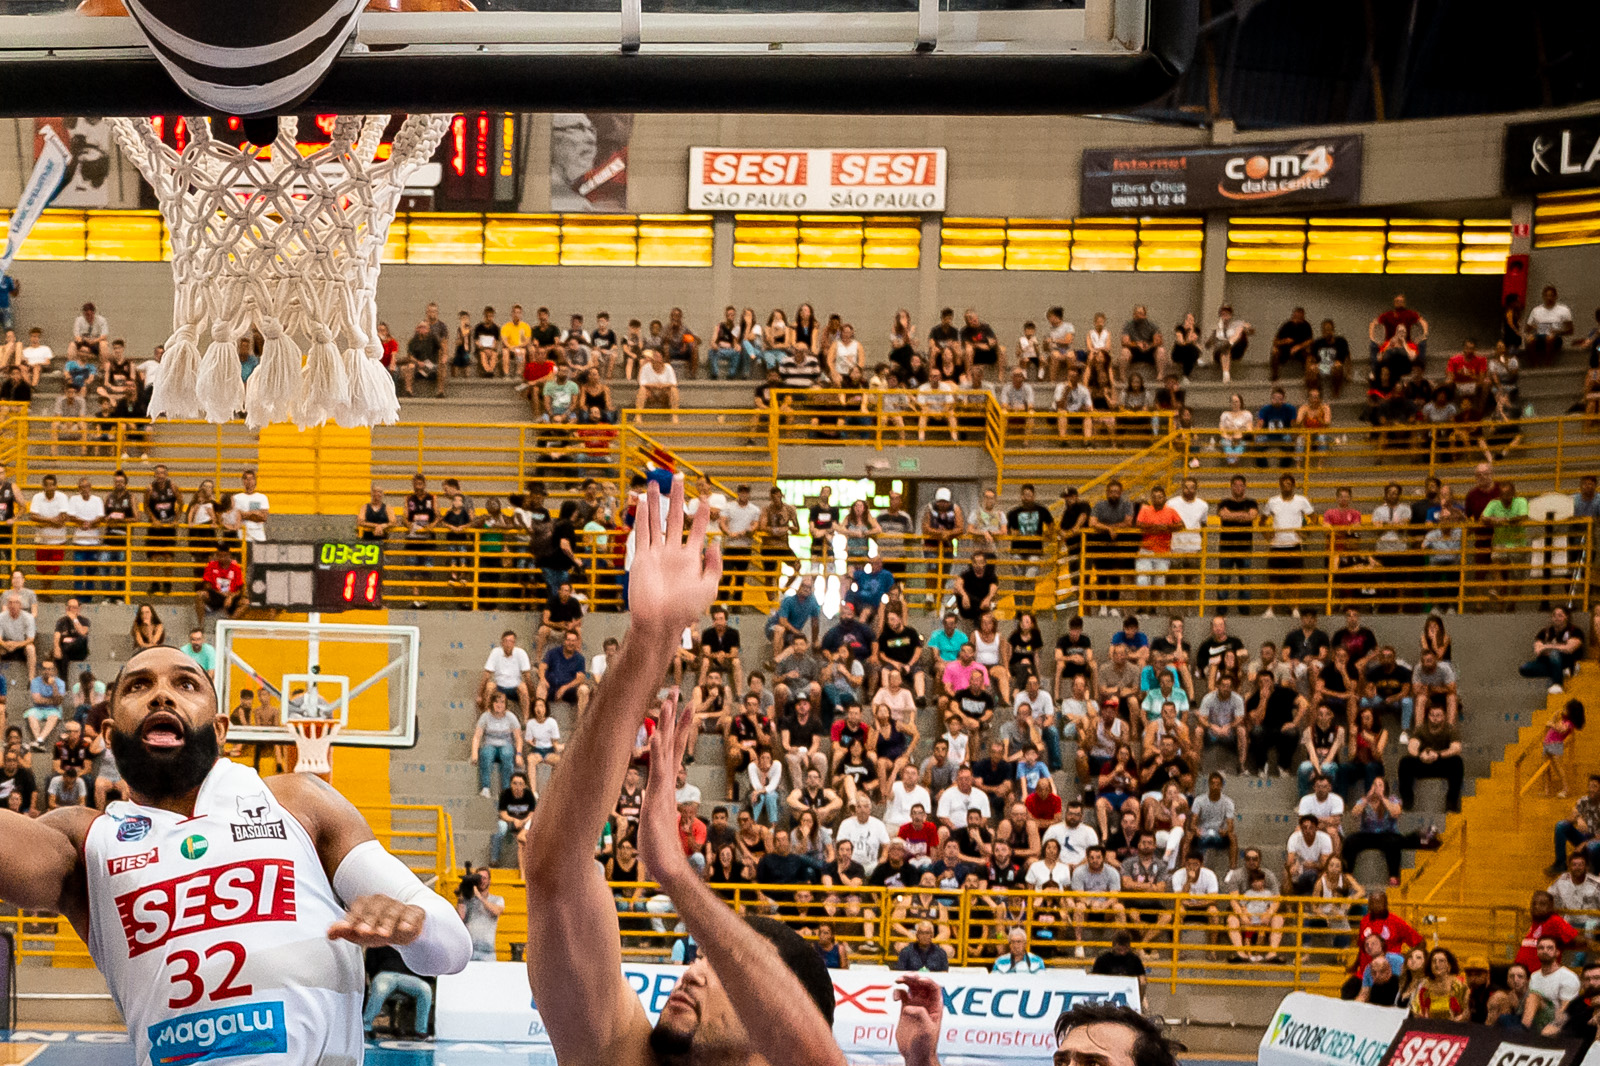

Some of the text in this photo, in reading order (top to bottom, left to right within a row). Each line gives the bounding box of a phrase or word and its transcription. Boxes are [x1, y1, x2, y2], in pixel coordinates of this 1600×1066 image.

[709, 154, 800, 185] SESI
[838, 154, 929, 185] SESI
[1241, 179, 1277, 194] data
[702, 190, 808, 209] SÃO PAULO
[829, 190, 935, 209] SÃO PAULO
[320, 543, 380, 565] 03:29
[342, 570, 379, 602] 11
[235, 823, 286, 841] BASQUETE
[112, 850, 157, 873] FIESP
[132, 864, 279, 945] SESI
[165, 941, 253, 1010] 32
[156, 1008, 274, 1048] Magalu
[946, 1027, 959, 1042] e
[964, 1028, 1055, 1050] construç
